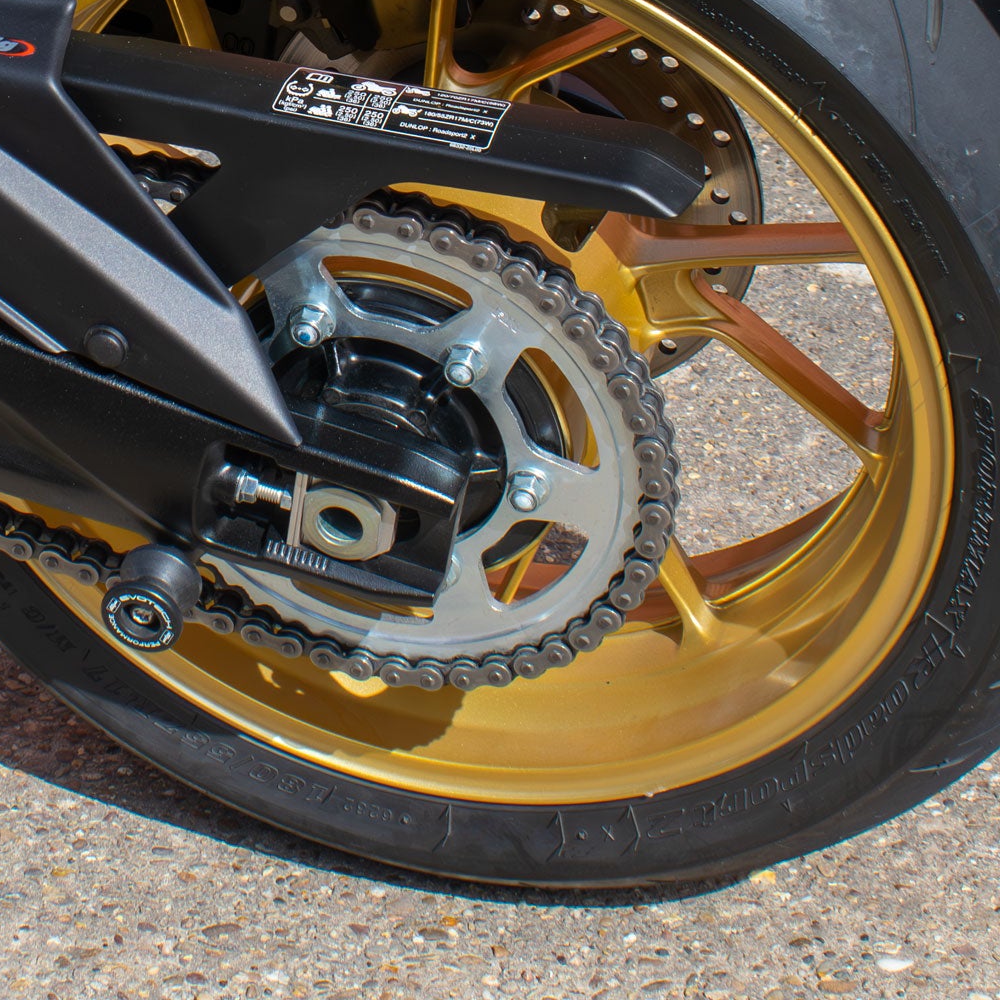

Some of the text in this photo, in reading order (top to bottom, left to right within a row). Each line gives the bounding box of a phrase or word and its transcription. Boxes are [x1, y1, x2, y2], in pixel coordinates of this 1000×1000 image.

[413, 97, 441, 106] DUNLOP
[399, 121, 429, 131] DUNLOP
[119, 594, 173, 630] EVOTECH
[108, 613, 161, 648] PERFORMANCE
